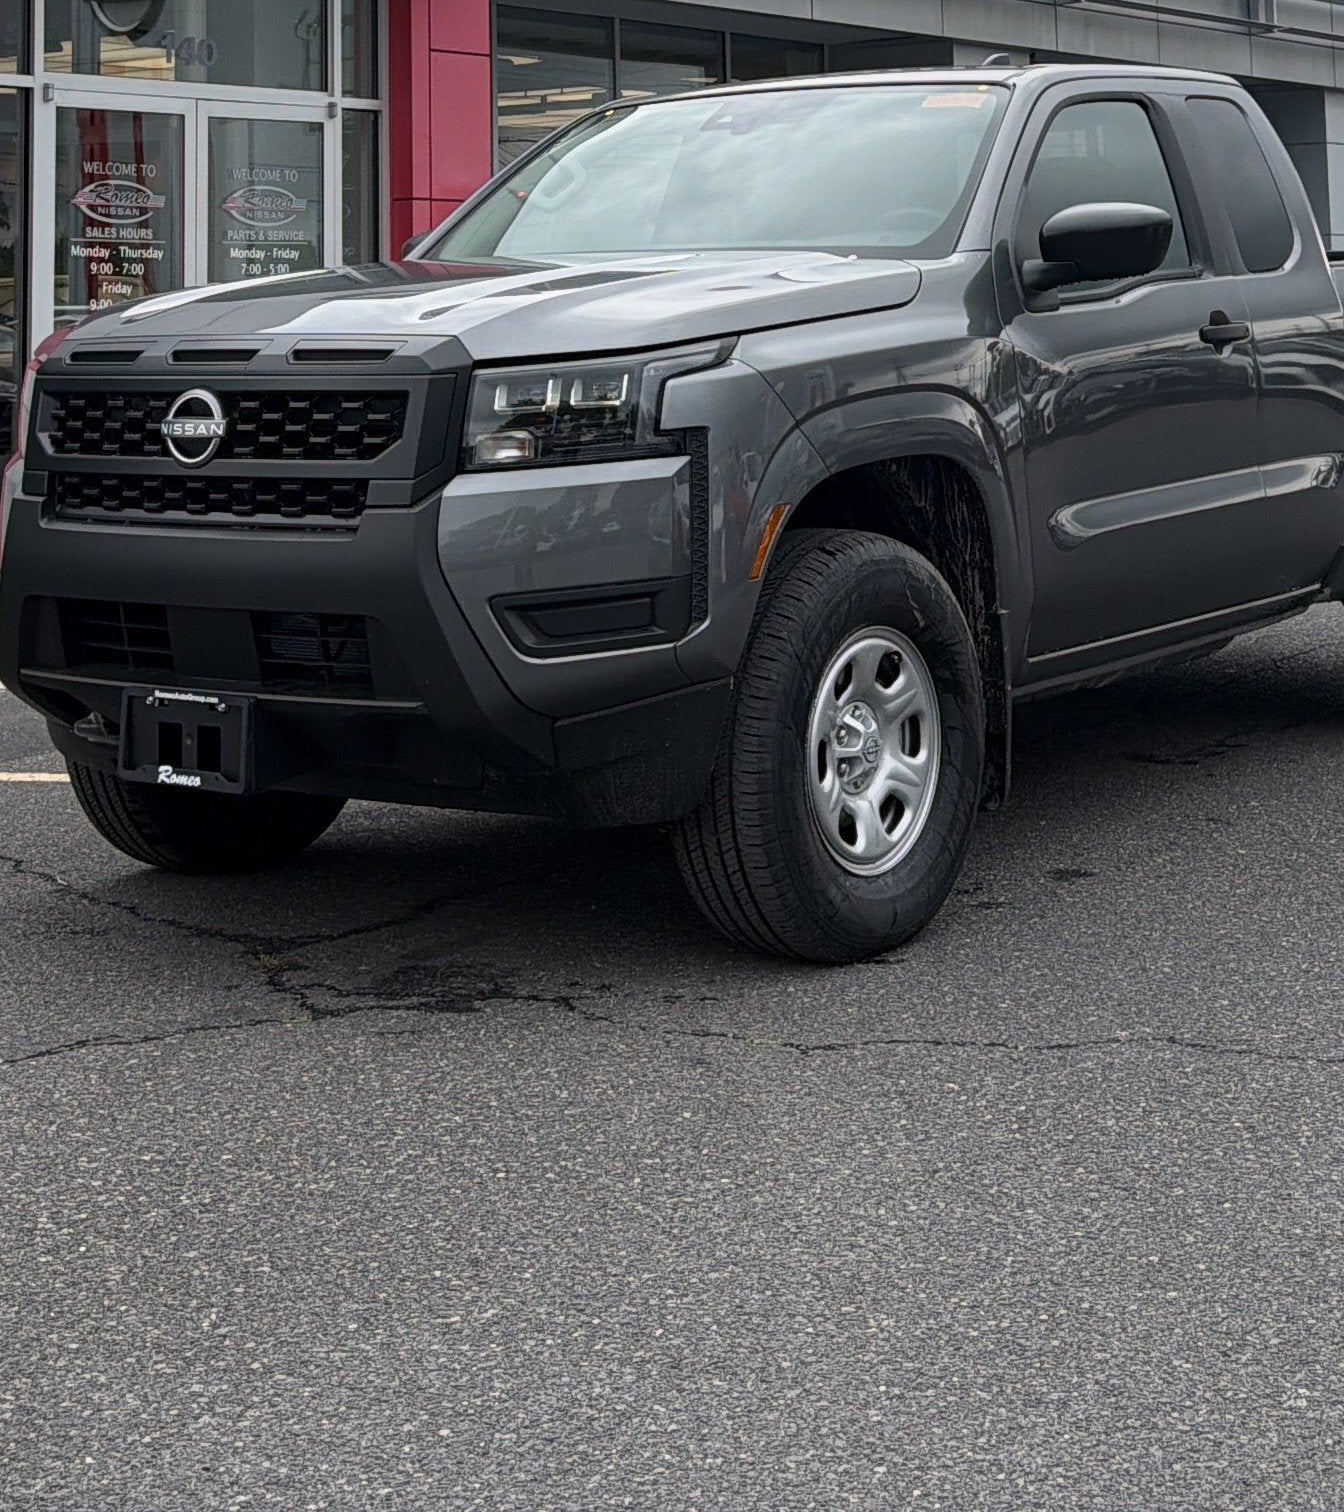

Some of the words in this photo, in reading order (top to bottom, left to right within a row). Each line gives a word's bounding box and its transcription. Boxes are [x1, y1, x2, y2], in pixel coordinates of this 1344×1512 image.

[83, 161, 137, 177] WELCOME
[141, 164, 157, 178] TO
[232, 168, 281, 182] WELCOME
[285, 170, 299, 183] TO
[93, 183, 151, 205] Romeo
[97, 206, 140, 216] NISSAN
[246, 211, 285, 219] NISSAN
[85, 226, 117, 238] SALES
[120, 228, 154, 239] HOURS
[227, 230, 256, 241] PARTS
[259, 231, 265, 241] &
[268, 231, 305, 241] SERVICE
[71, 245, 111, 260] Monday
[119, 245, 165, 261] Thursday
[230, 248, 266, 261] Monday
[273, 248, 300, 261] Friday
[90, 263, 113, 275] 9:00
[122, 263, 145, 275] 7:00
[241, 263, 262, 275] 7:00
[102, 281, 133, 295] Friday
[161, 423, 224, 435] NISSAN
[157, 765, 202, 787] Romeo
